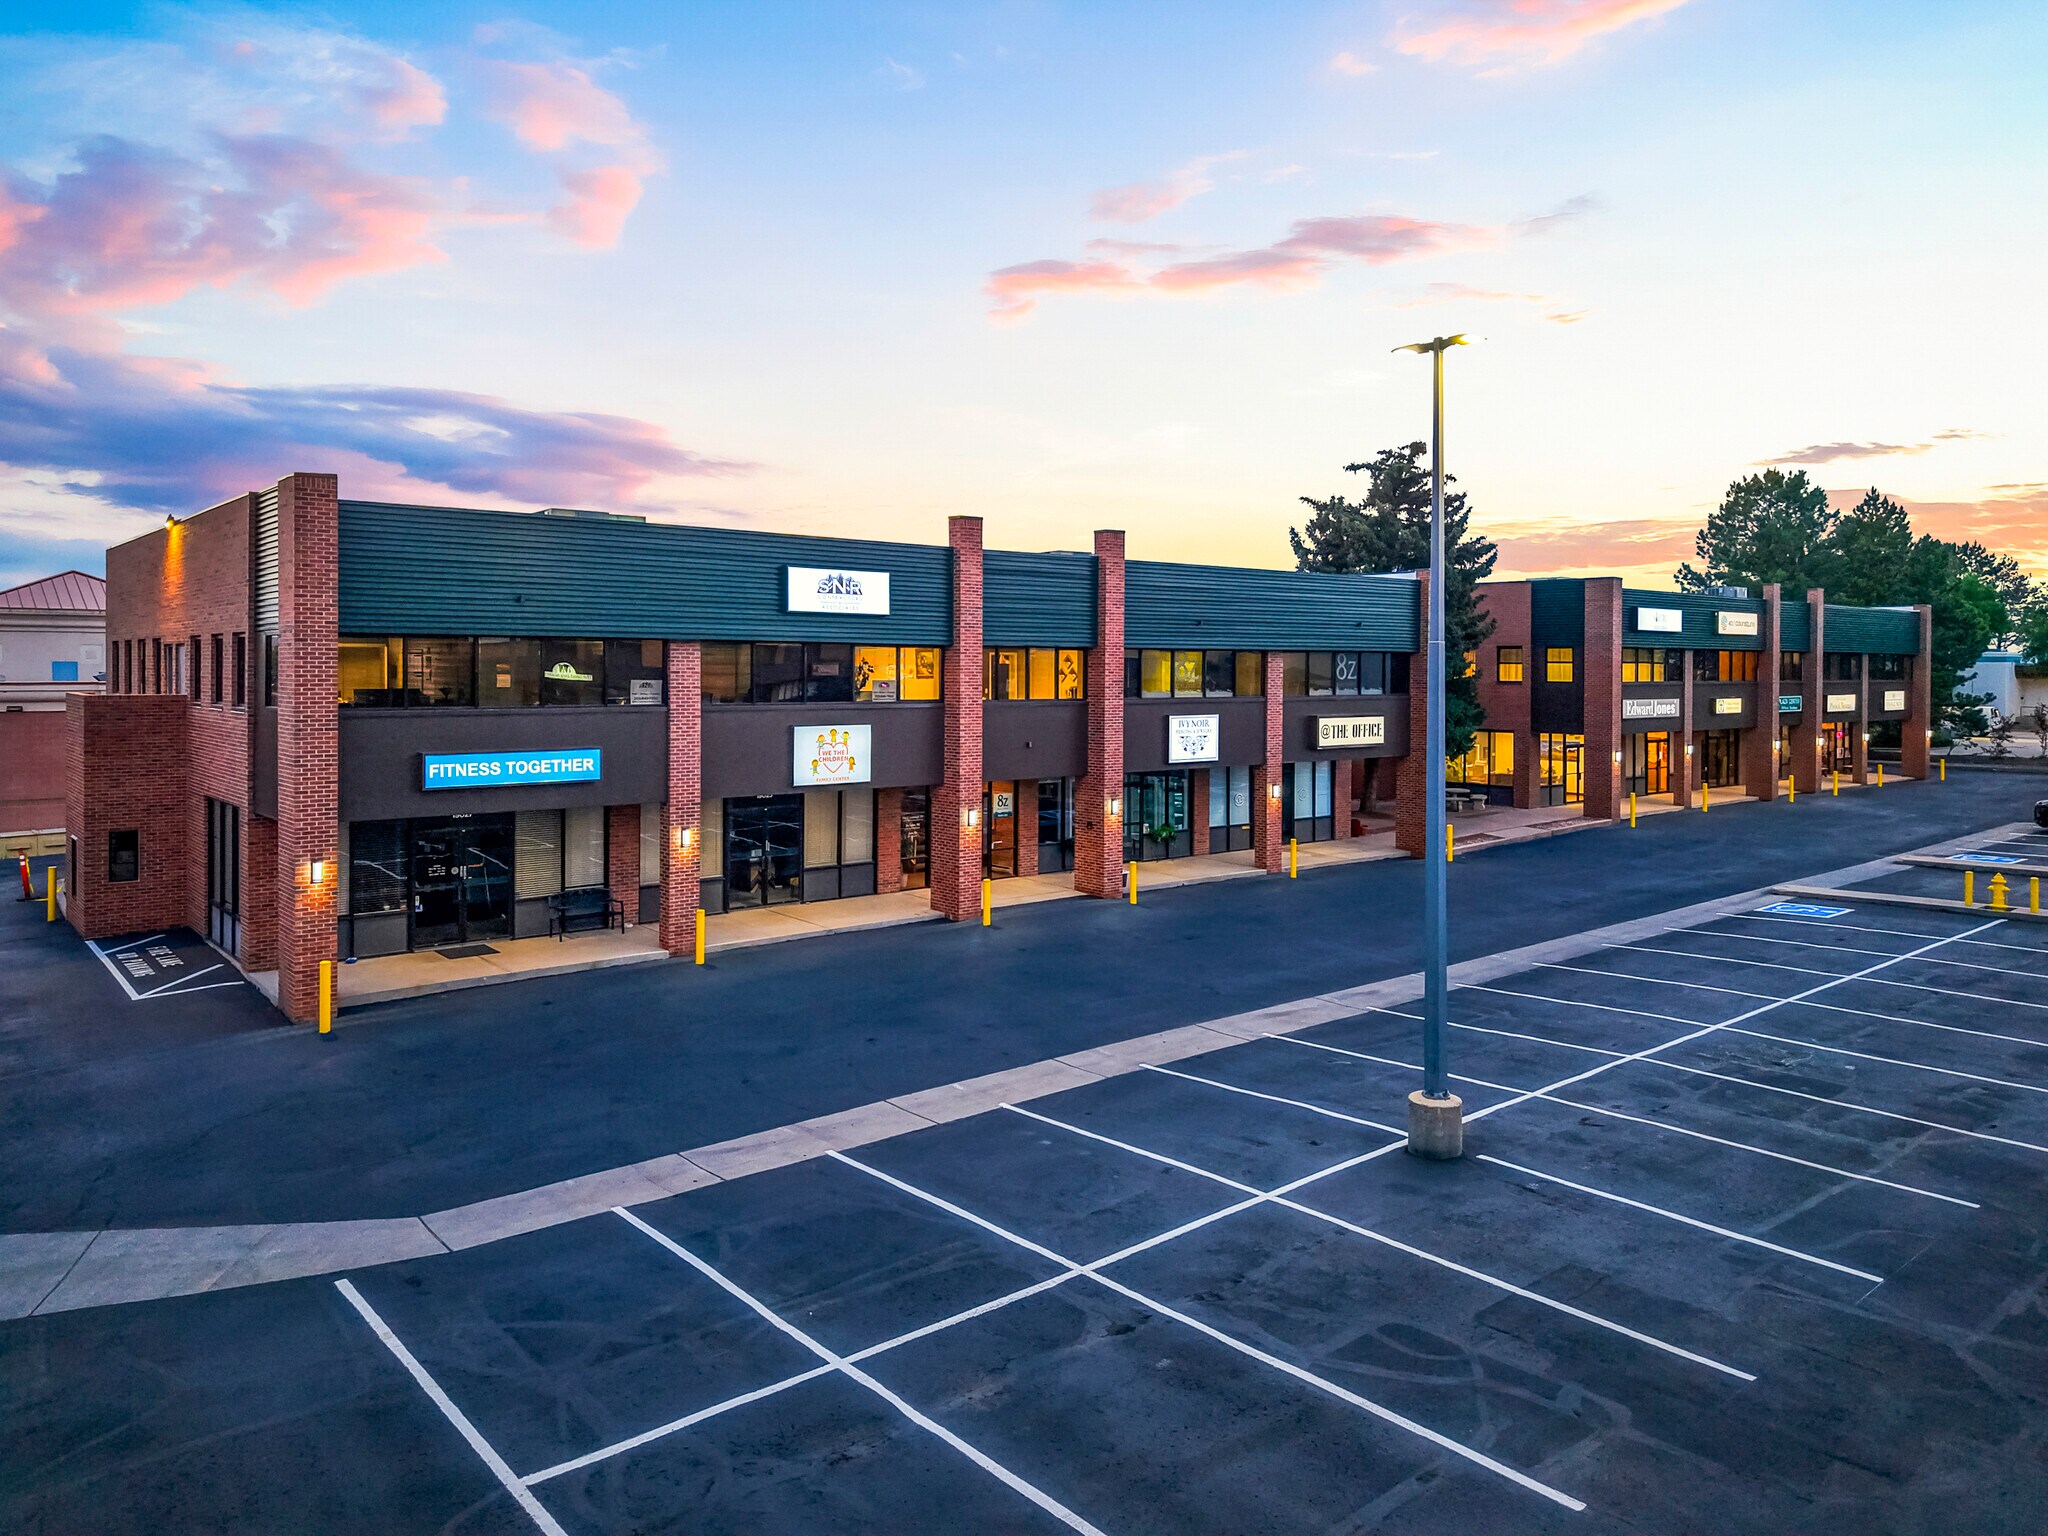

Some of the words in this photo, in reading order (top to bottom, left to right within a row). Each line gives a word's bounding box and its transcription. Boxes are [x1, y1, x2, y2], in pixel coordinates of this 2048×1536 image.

[818, 577, 863, 595] SNR
[1626, 699, 1654, 716] Edward
[1653, 699, 1676, 717] Jones
[1178, 719, 1190, 728] IVY
[1191, 719, 1210, 728] NOIR
[1352, 722, 1382, 738] OFFICE
[429, 762, 501, 778] FITNESS
[505, 758, 594, 774] TOGETHER
